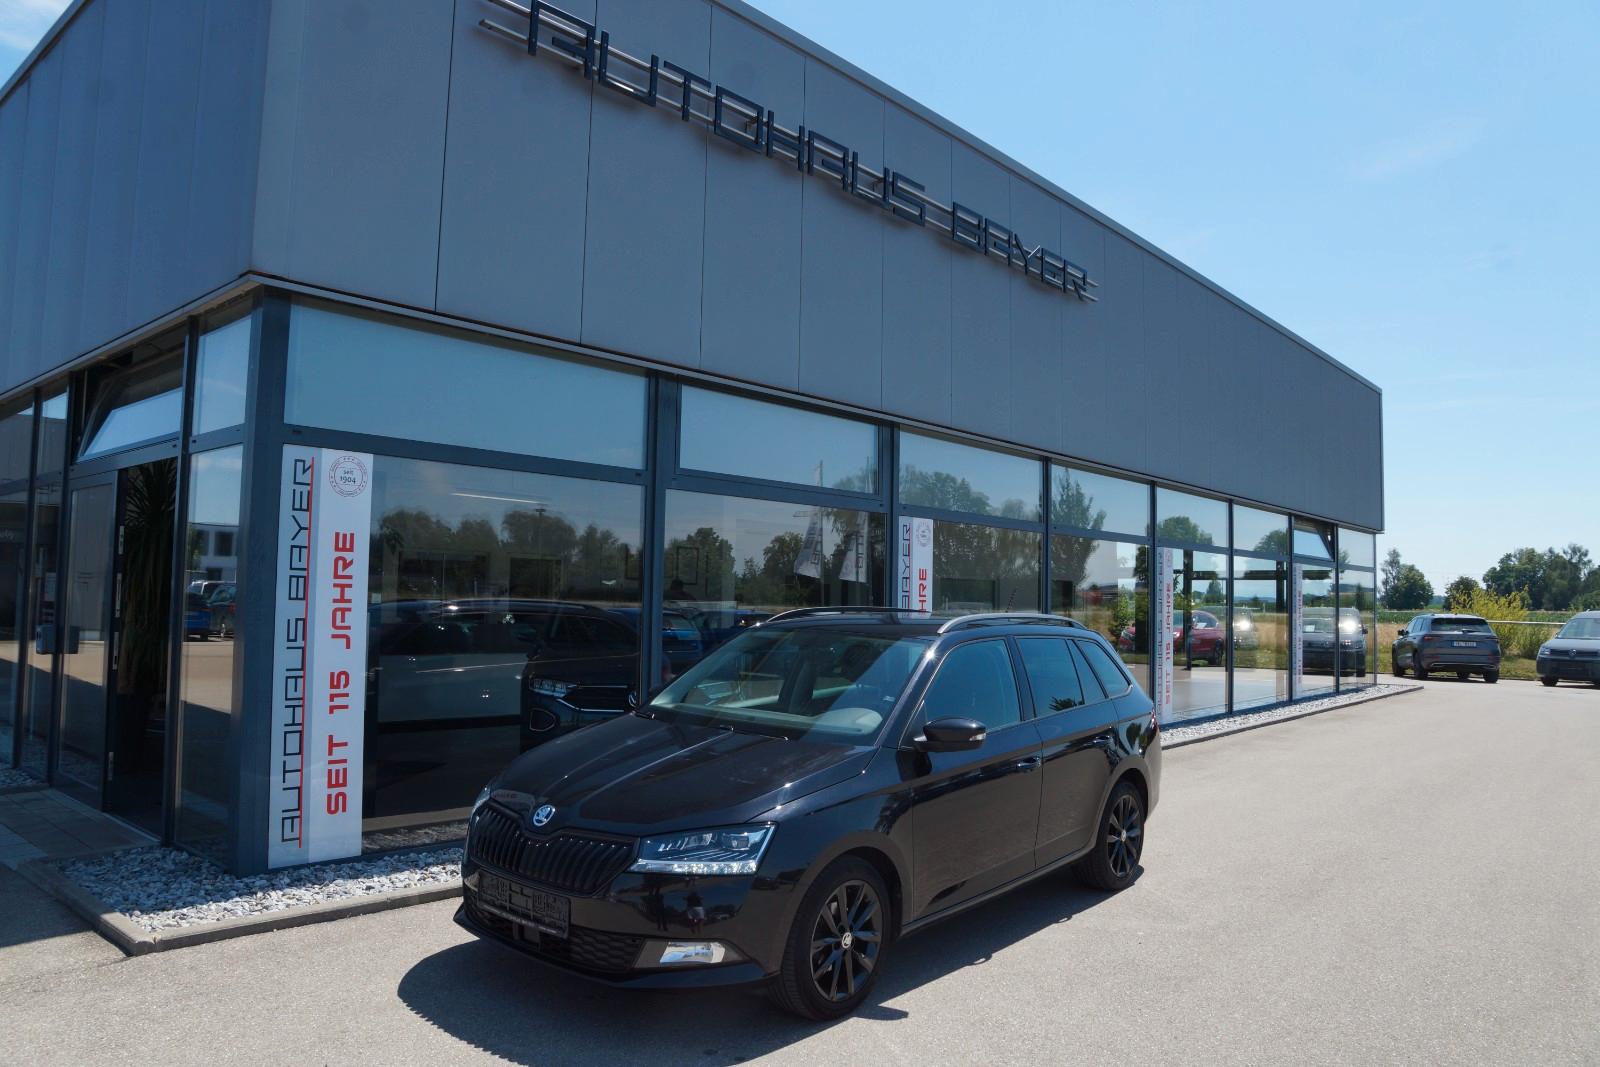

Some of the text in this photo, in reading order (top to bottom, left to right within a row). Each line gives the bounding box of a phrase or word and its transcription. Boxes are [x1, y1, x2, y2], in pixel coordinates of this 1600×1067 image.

[528, 0, 1088, 301] AUTOHAUS BAYER
[340, 475, 356, 484] 1904
[918, 568, 927, 612] HRE
[281, 459, 312, 842] AUTOHAUS BAYER
[326, 531, 355, 815] SEIT 115 JAHRE
